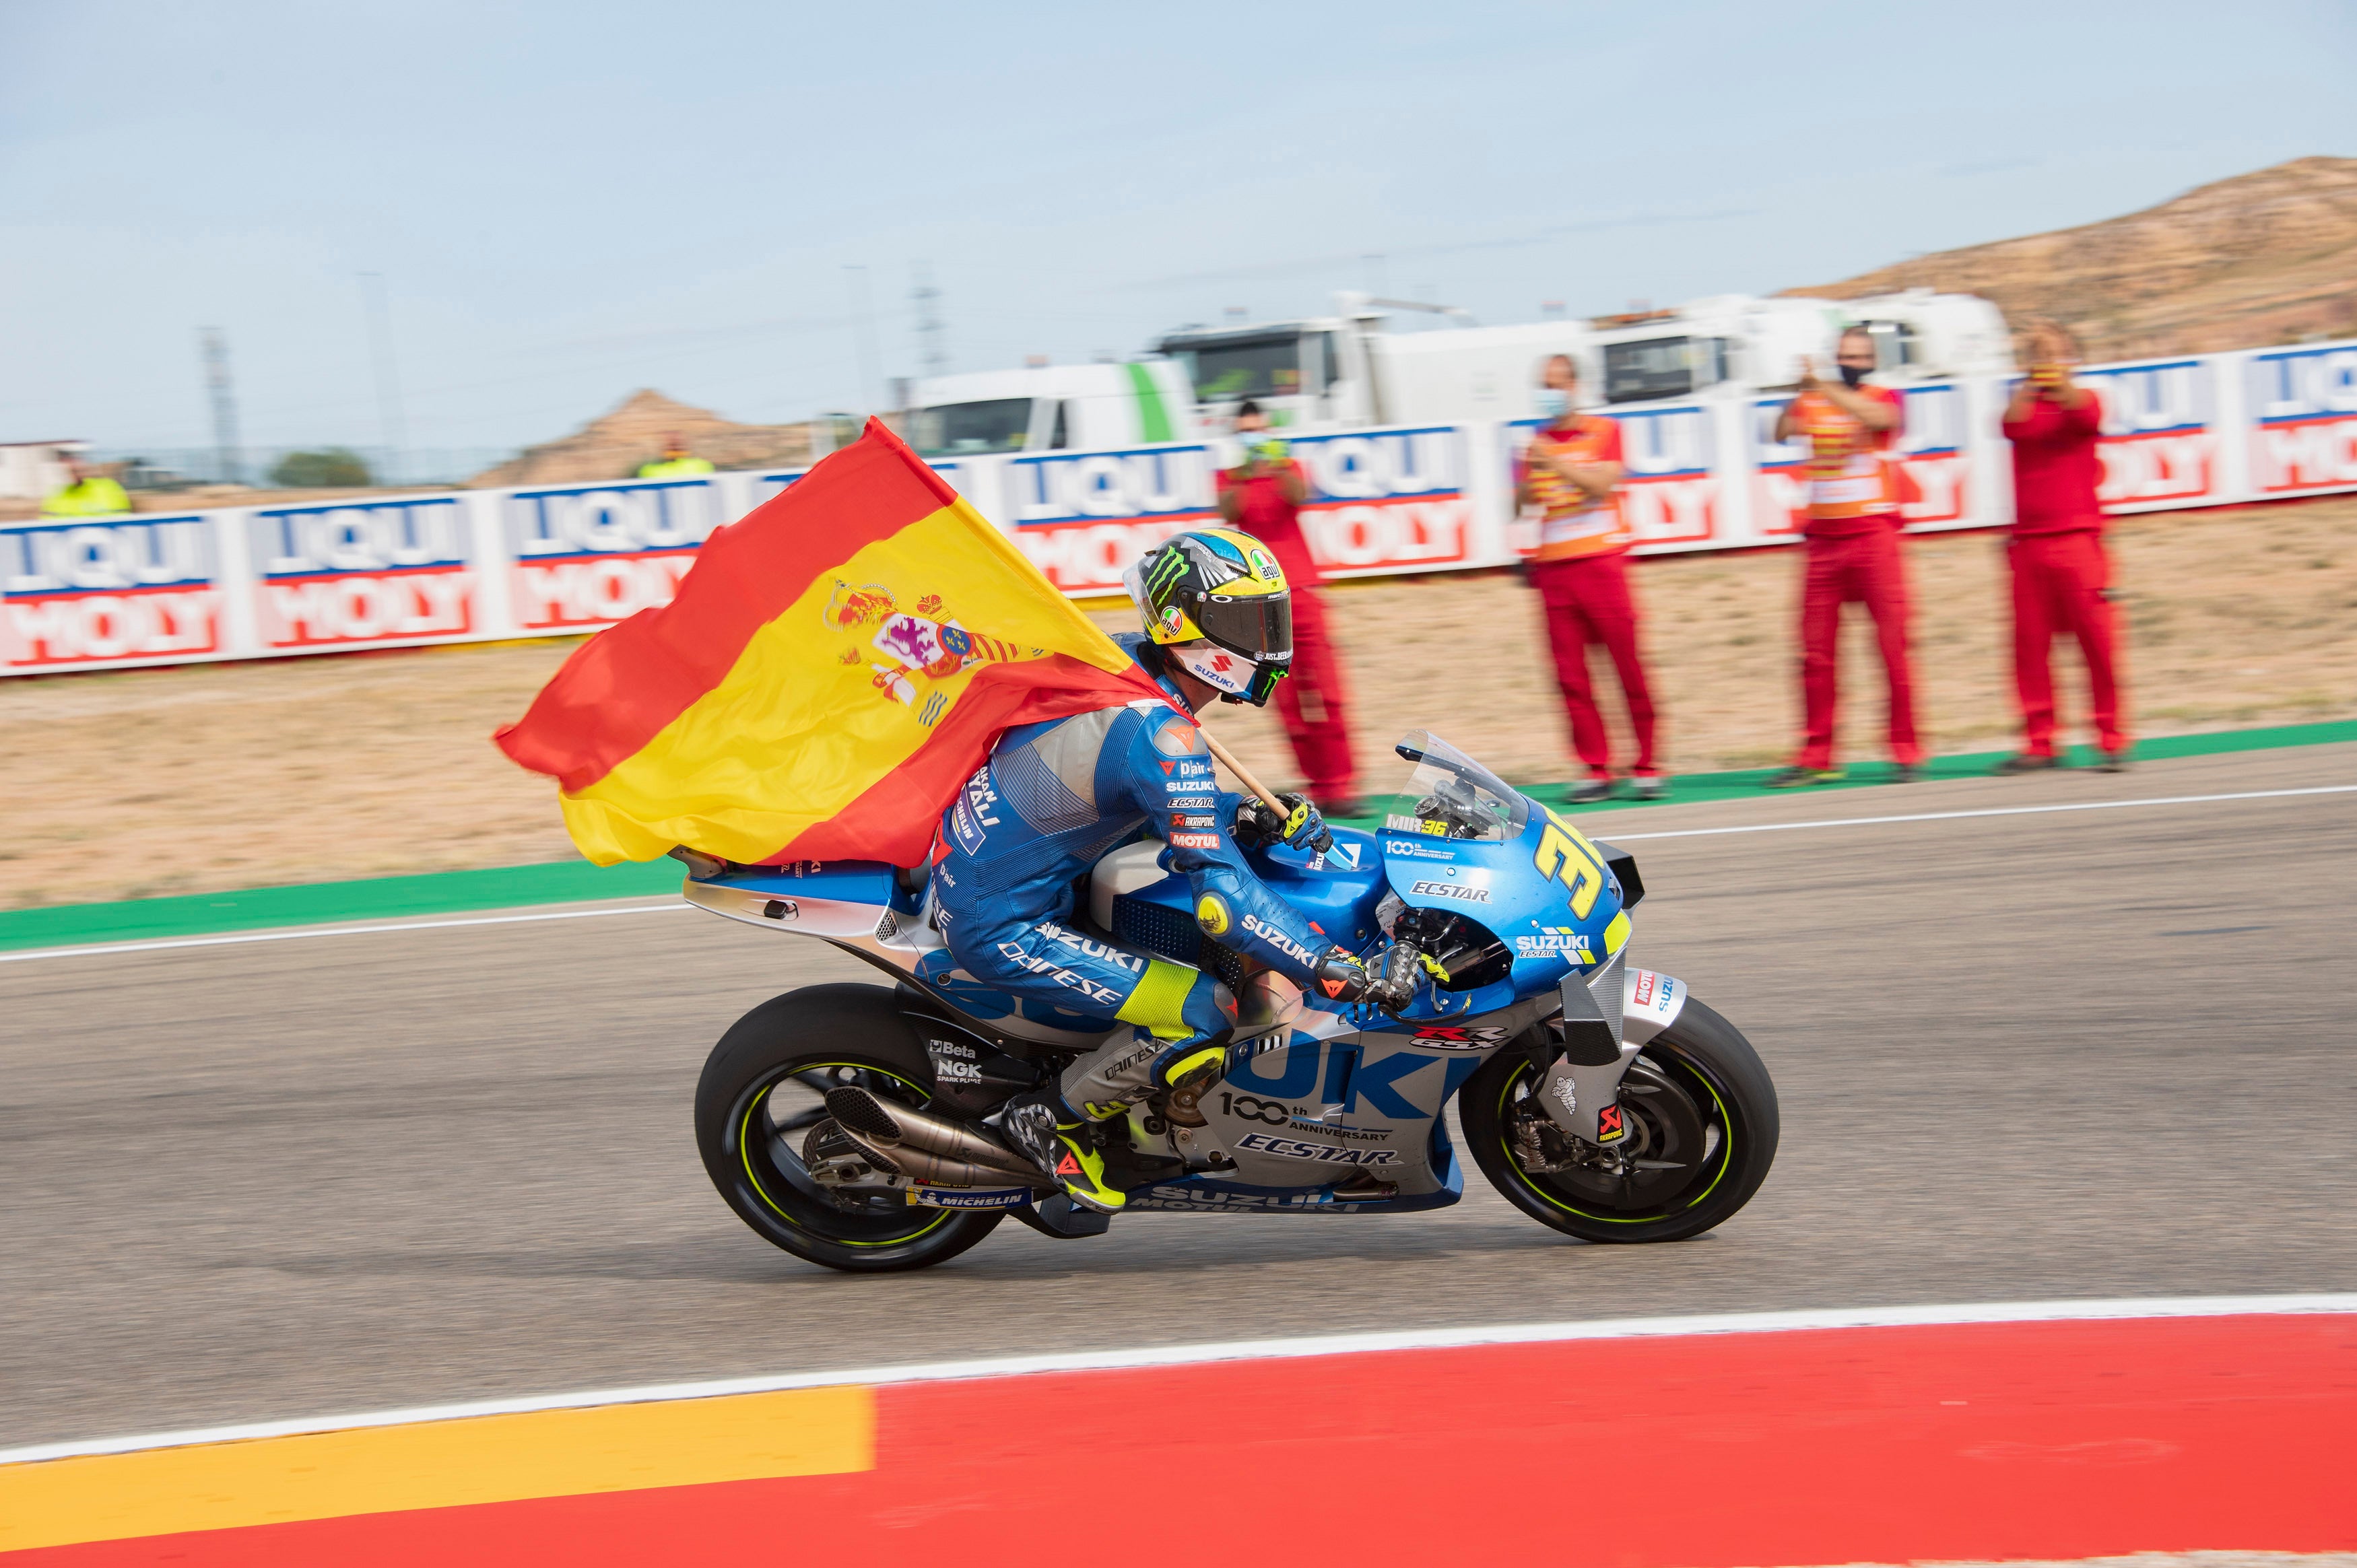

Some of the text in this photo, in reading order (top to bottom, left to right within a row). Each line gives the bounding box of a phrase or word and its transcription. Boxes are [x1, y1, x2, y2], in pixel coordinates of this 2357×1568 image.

[1194, 664, 1234, 688] SUZUKI
[1166, 782, 1215, 792] SUZUKI
[968, 771, 1000, 827] YALI
[1167, 797, 1215, 808] ECSTAR
[956, 797, 974, 840] CHELIN
[1386, 813, 1448, 836] MIR 36
[1172, 835, 1218, 847] MOTUL
[1385, 840, 1414, 855] 100
[1414, 852, 1453, 860] ANNIVERSARY
[1410, 881, 1492, 904] ECSTAR
[1241, 913, 1319, 969] SUZUKI
[1516, 934, 1589, 950] SUZUKI
[1519, 950, 1558, 959] ECSTAR
[943, 1041, 976, 1059] Beta
[937, 1060, 983, 1079] NGK
[937, 1075, 959, 1083] SPARK
[1220, 1092, 1308, 1126] 100 th
[1289, 1122, 1389, 1142] ANNIVERSARY
[1234, 1133, 1405, 1166] ECSTAR
[941, 1194, 1022, 1206] MICHELIN
